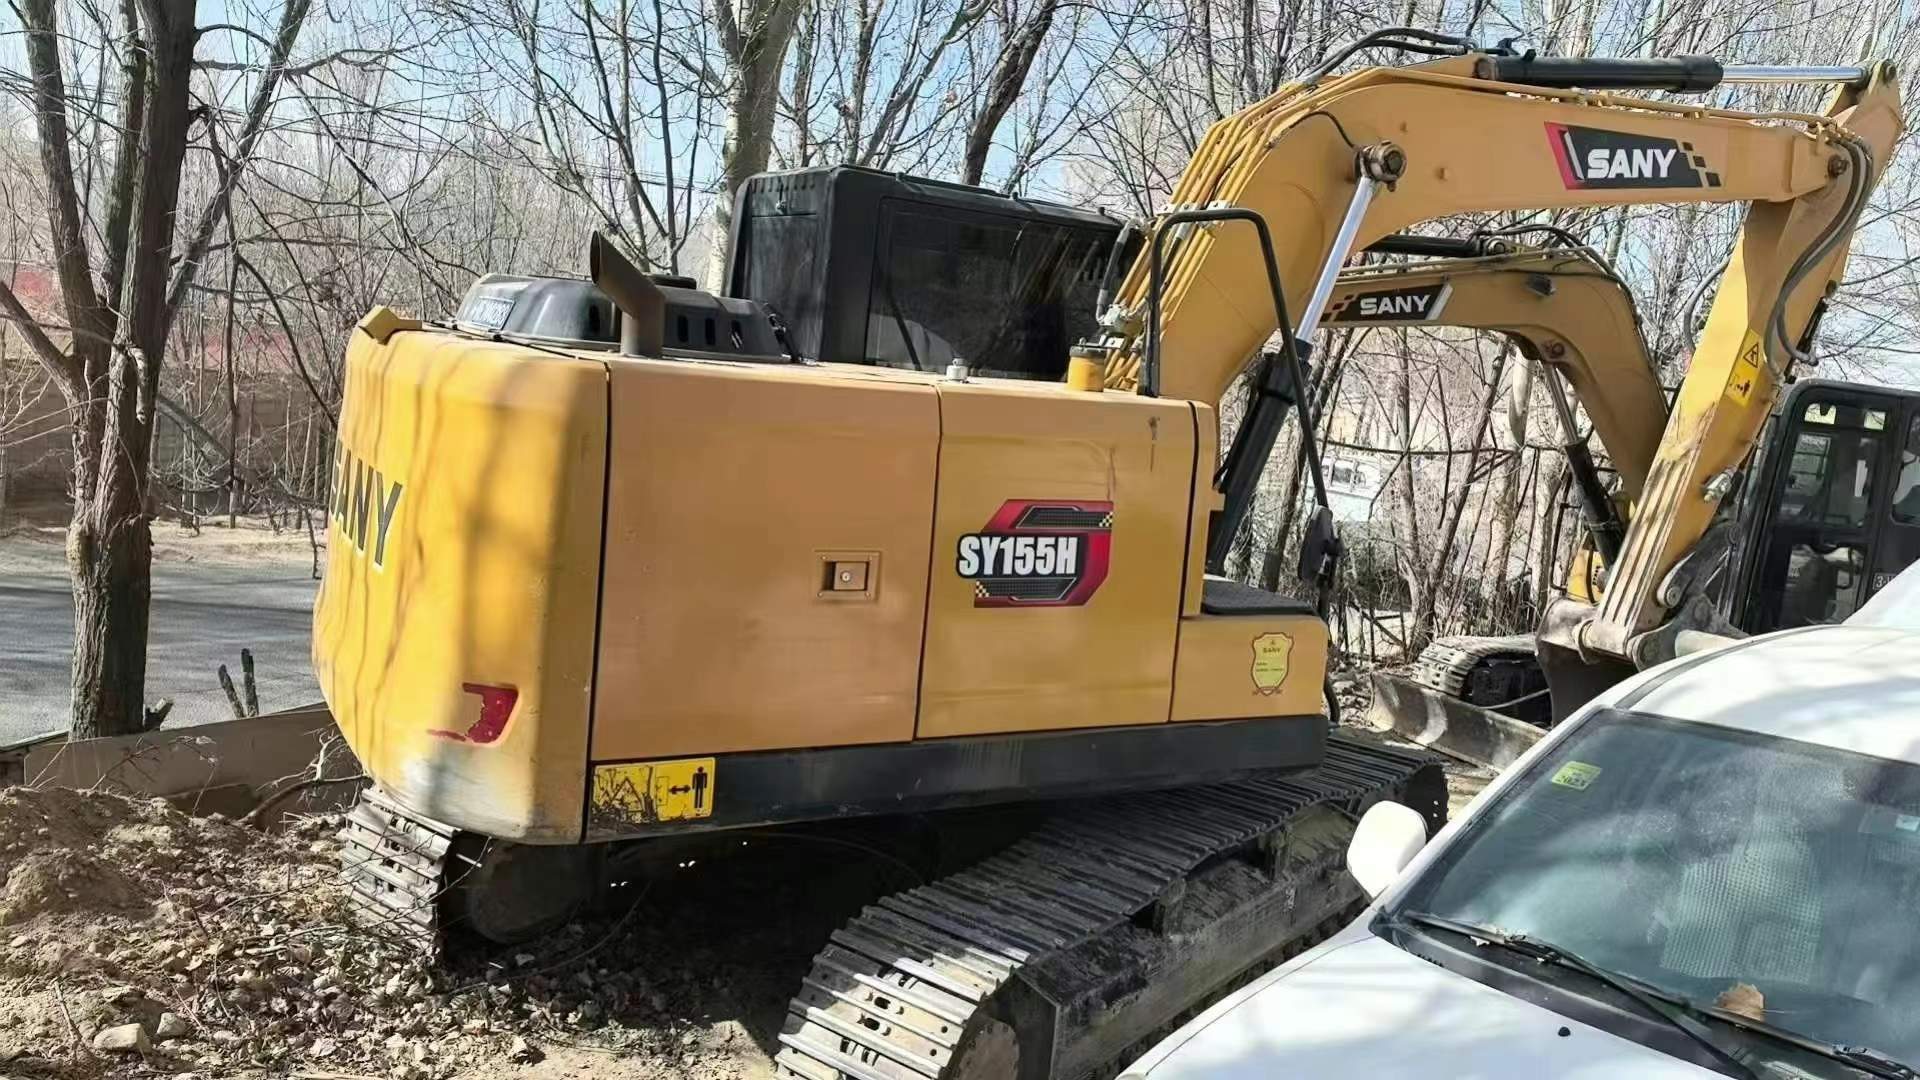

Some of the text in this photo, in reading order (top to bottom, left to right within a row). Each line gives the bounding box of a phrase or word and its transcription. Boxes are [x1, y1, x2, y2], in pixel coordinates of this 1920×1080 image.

[1587, 148, 1677, 179] SANY
[1360, 294, 1431, 315] SANY
[958, 535, 1078, 576] SY155H
